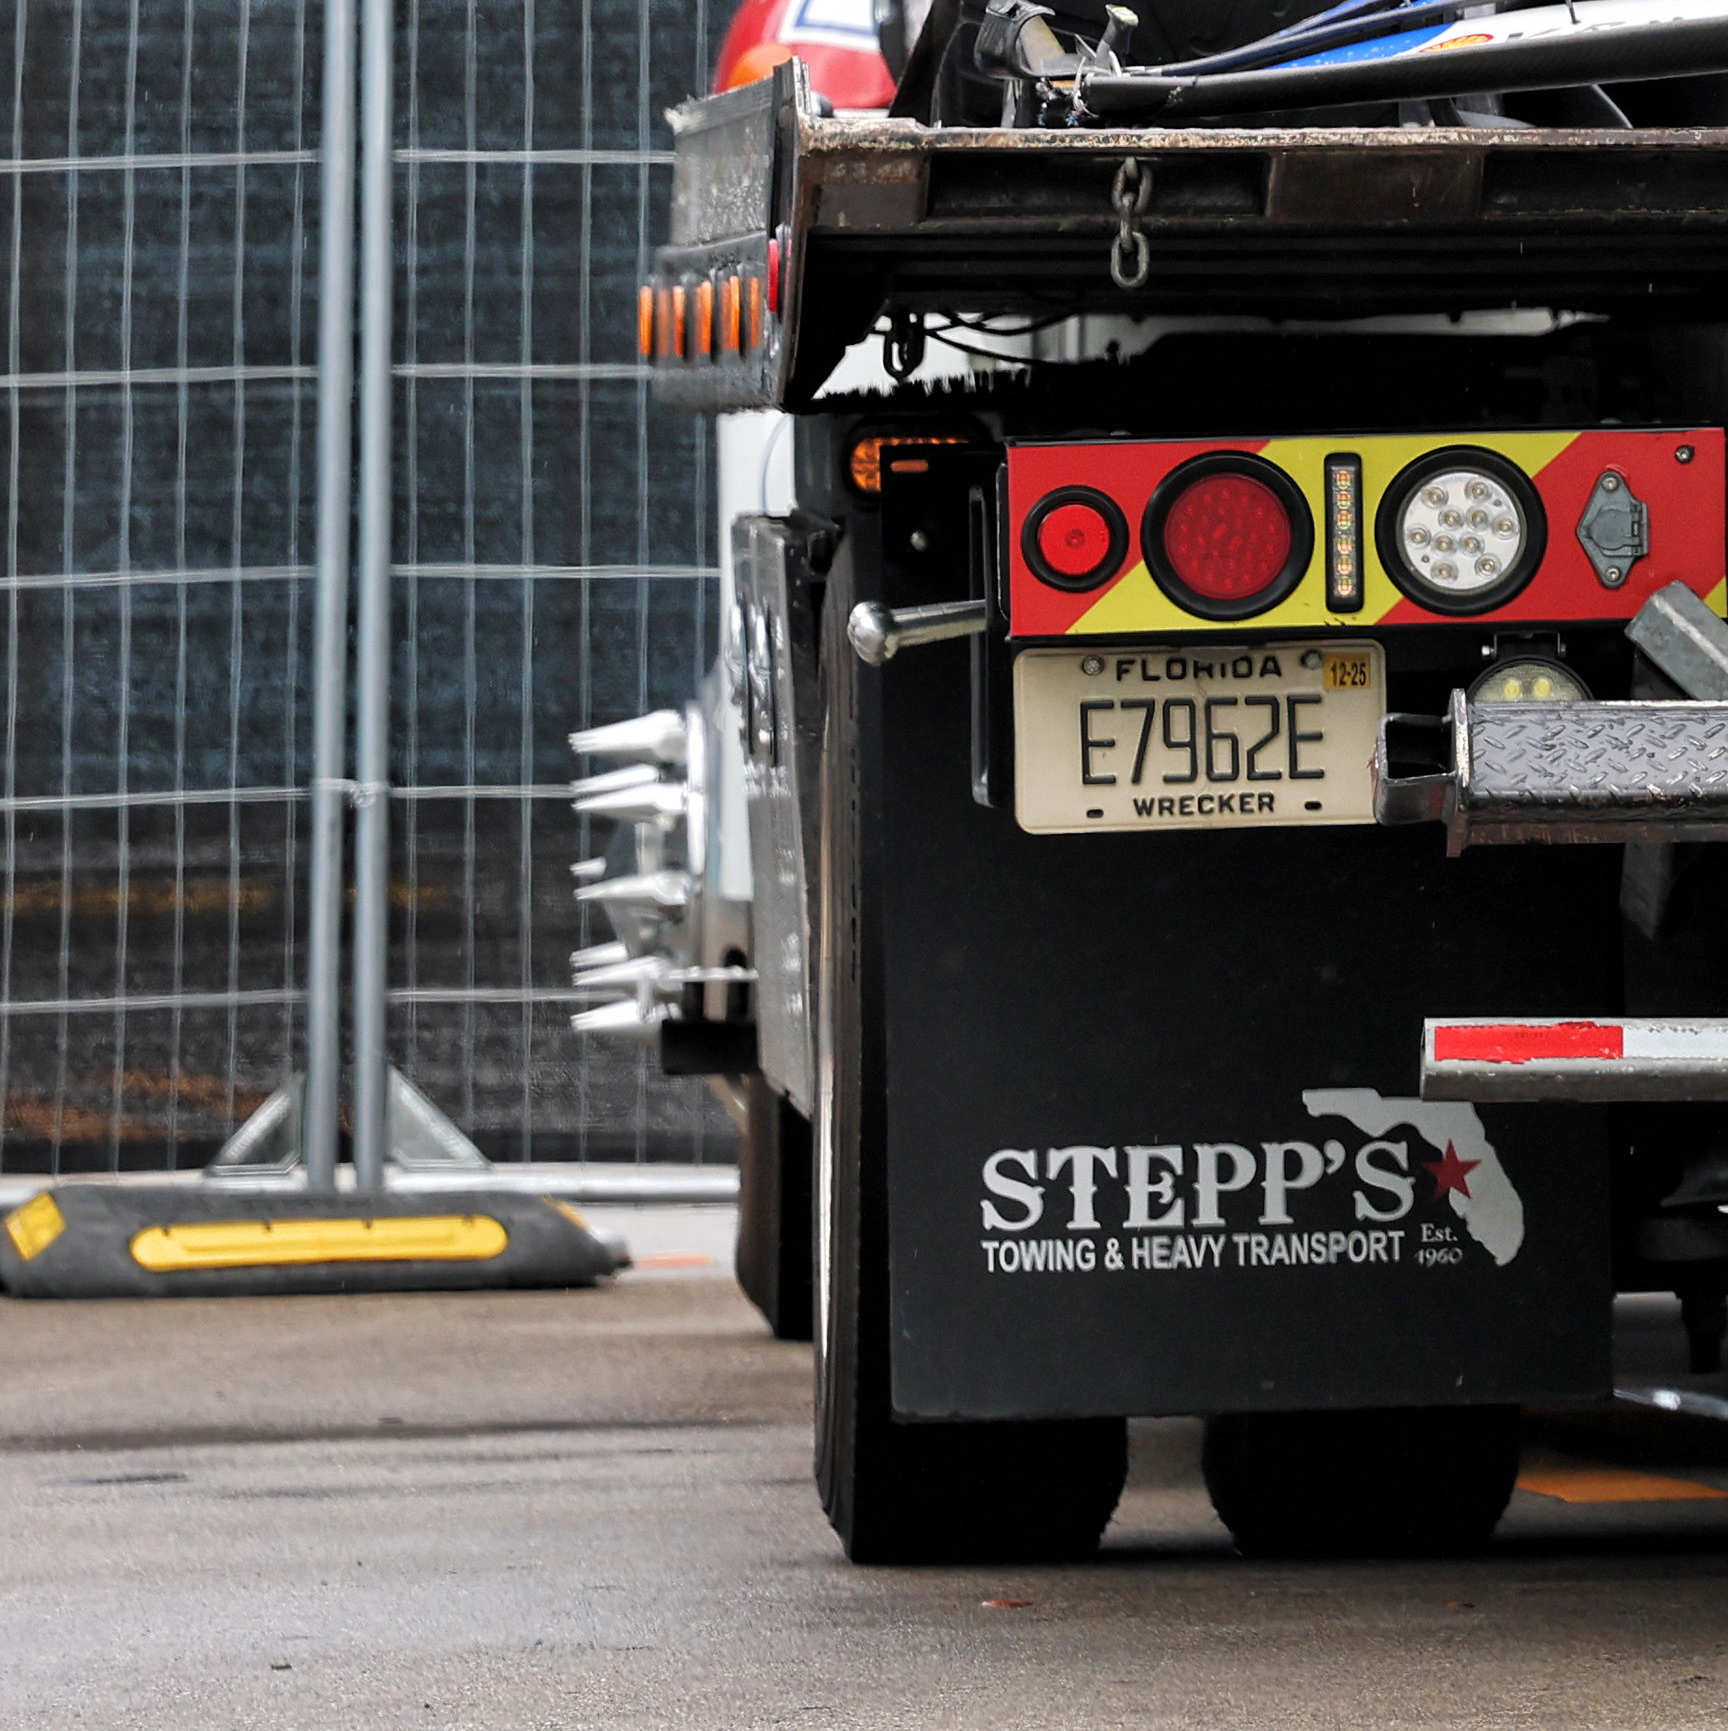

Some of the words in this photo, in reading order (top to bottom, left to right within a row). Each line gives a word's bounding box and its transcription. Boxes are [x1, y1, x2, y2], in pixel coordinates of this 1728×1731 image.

[1115, 655, 1283, 683] FLORIDA
[1079, 693, 1326, 785] E7962E
[1132, 791, 1275, 817] WRECKER
[980, 1139, 1417, 1232] STEPP'S
[1420, 1222, 1458, 1243] Est.
[981, 1236, 1097, 1272] TOWING
[1104, 1237, 1125, 1270] &
[1132, 1233, 1225, 1269] HEAVY
[1232, 1230, 1405, 1267] TRANSPORT
[1414, 1245, 1463, 1267] 1960
